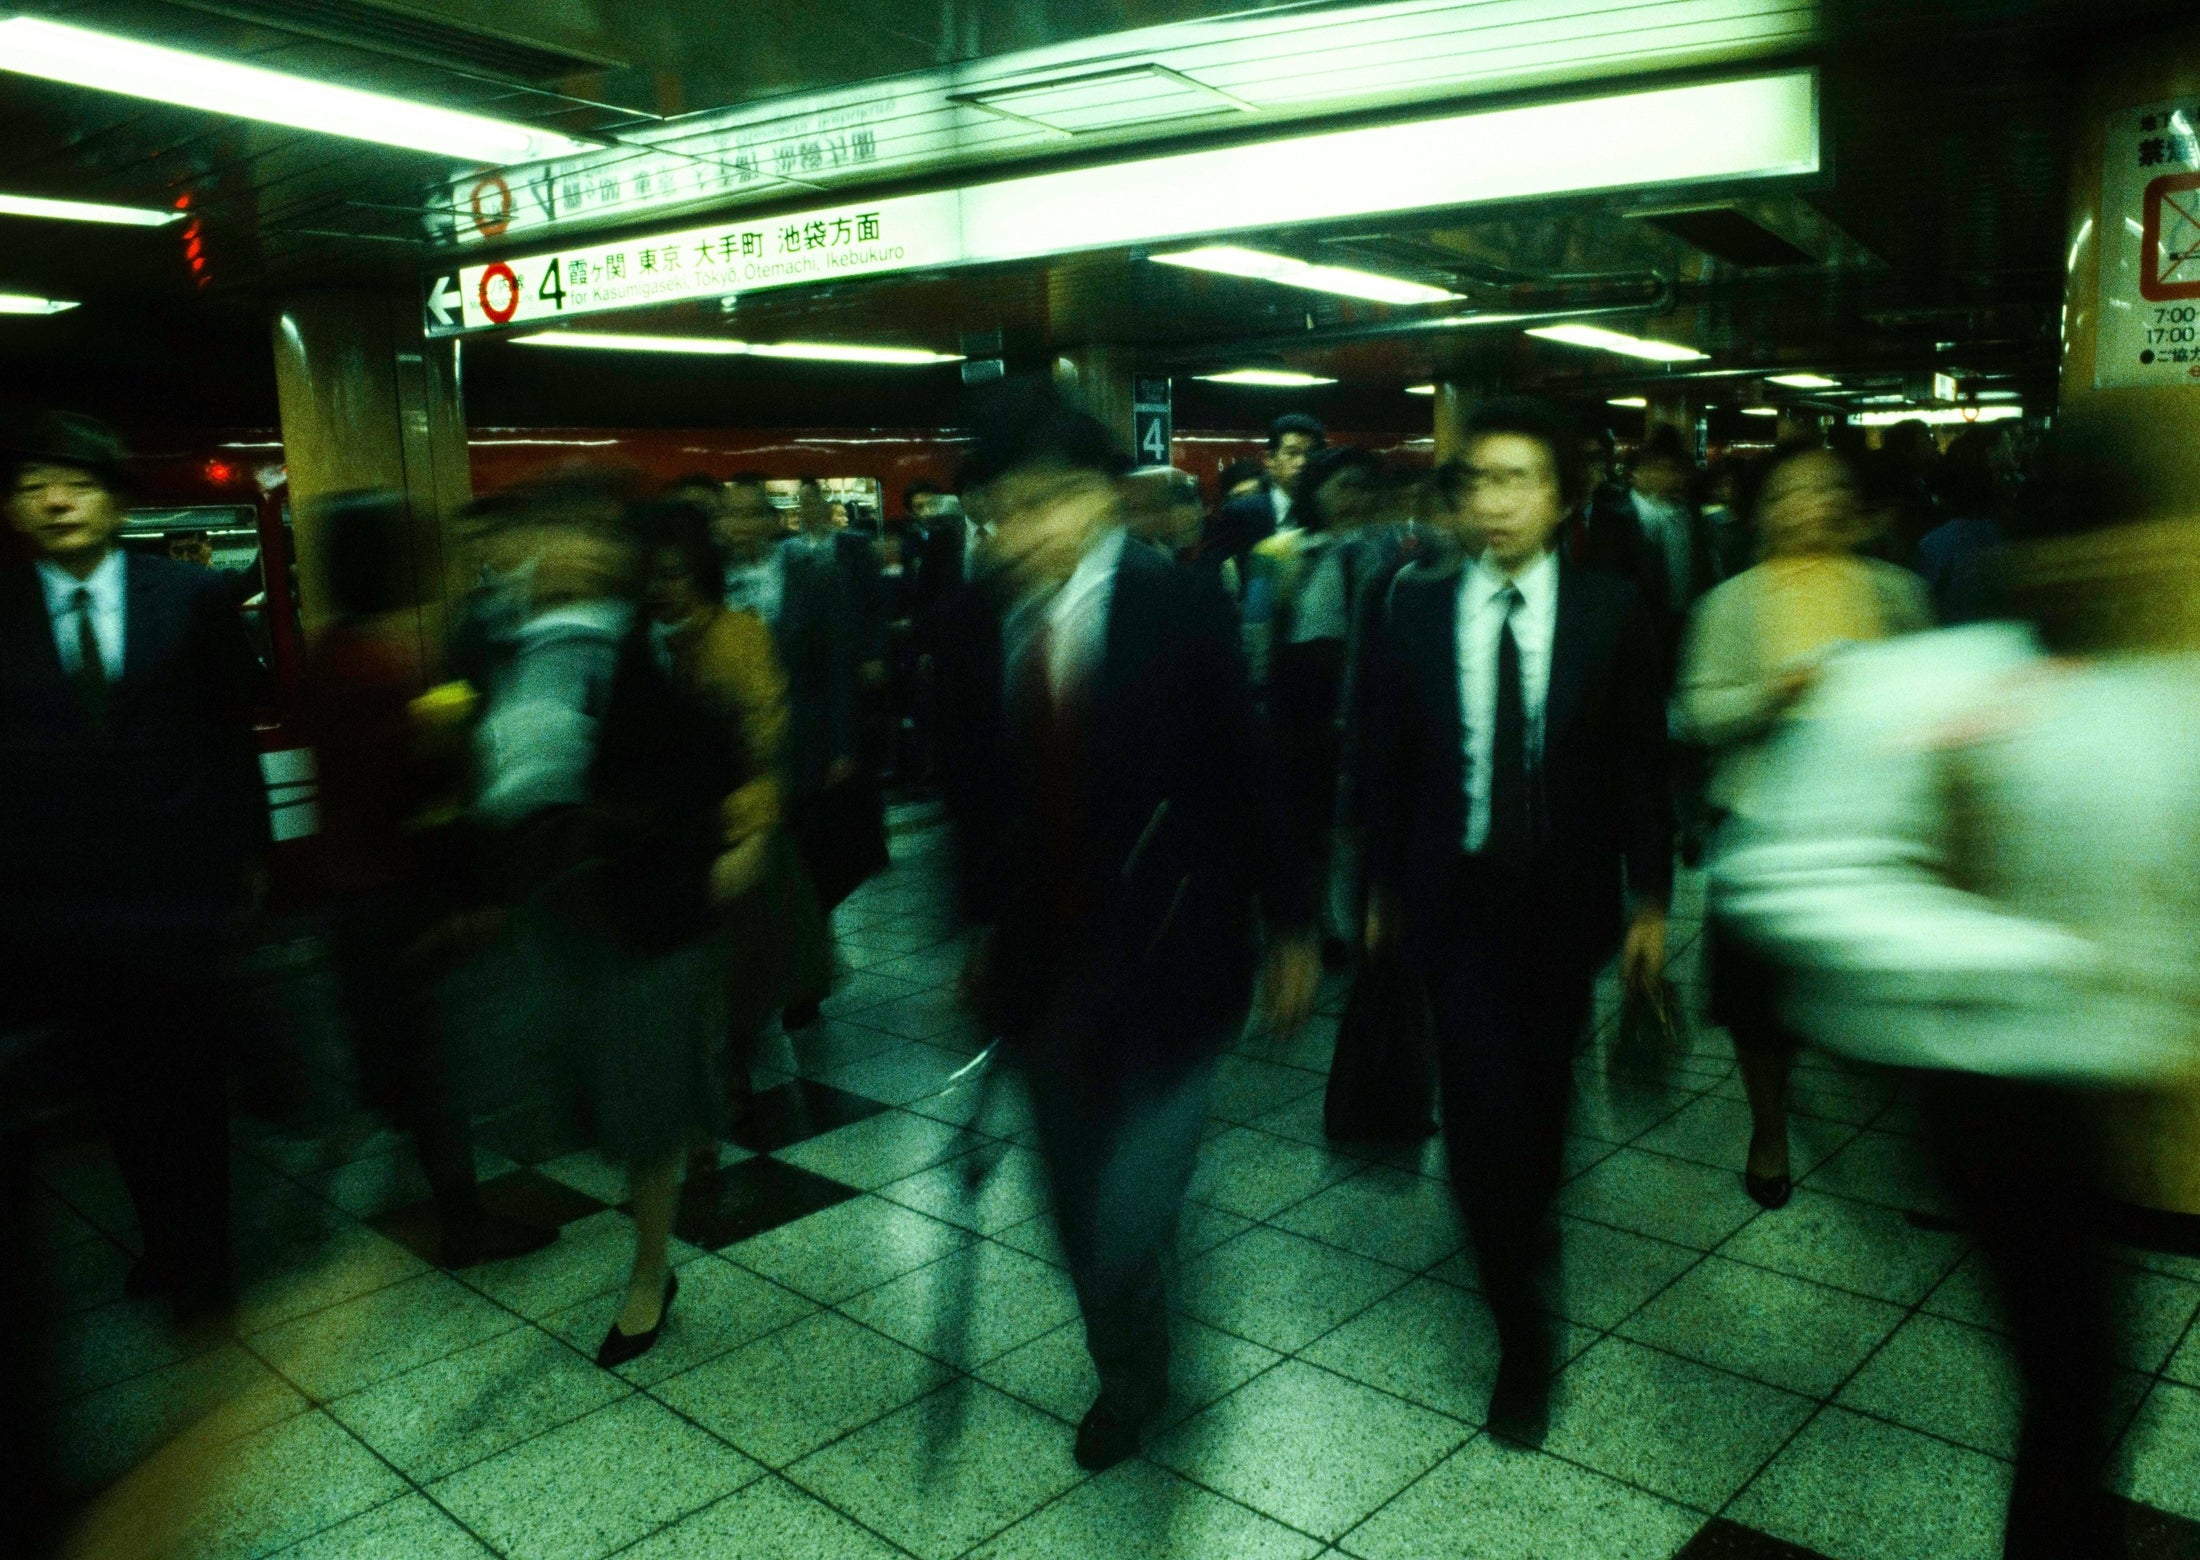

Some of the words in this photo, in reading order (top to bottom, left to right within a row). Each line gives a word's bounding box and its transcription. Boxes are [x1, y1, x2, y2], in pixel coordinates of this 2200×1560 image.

[638, 244, 682, 275] 東京
[693, 231, 764, 267] 大手町
[777, 211, 880, 254] 池袋方面
[538, 257, 567, 310] 4
[570, 291, 588, 306] for
[826, 245, 905, 269] Ikebukuro
[2147, 326, 2195, 344] 17:00
[2154, 306, 2196, 324] 7:00
[1142, 417, 1165, 461] 4
